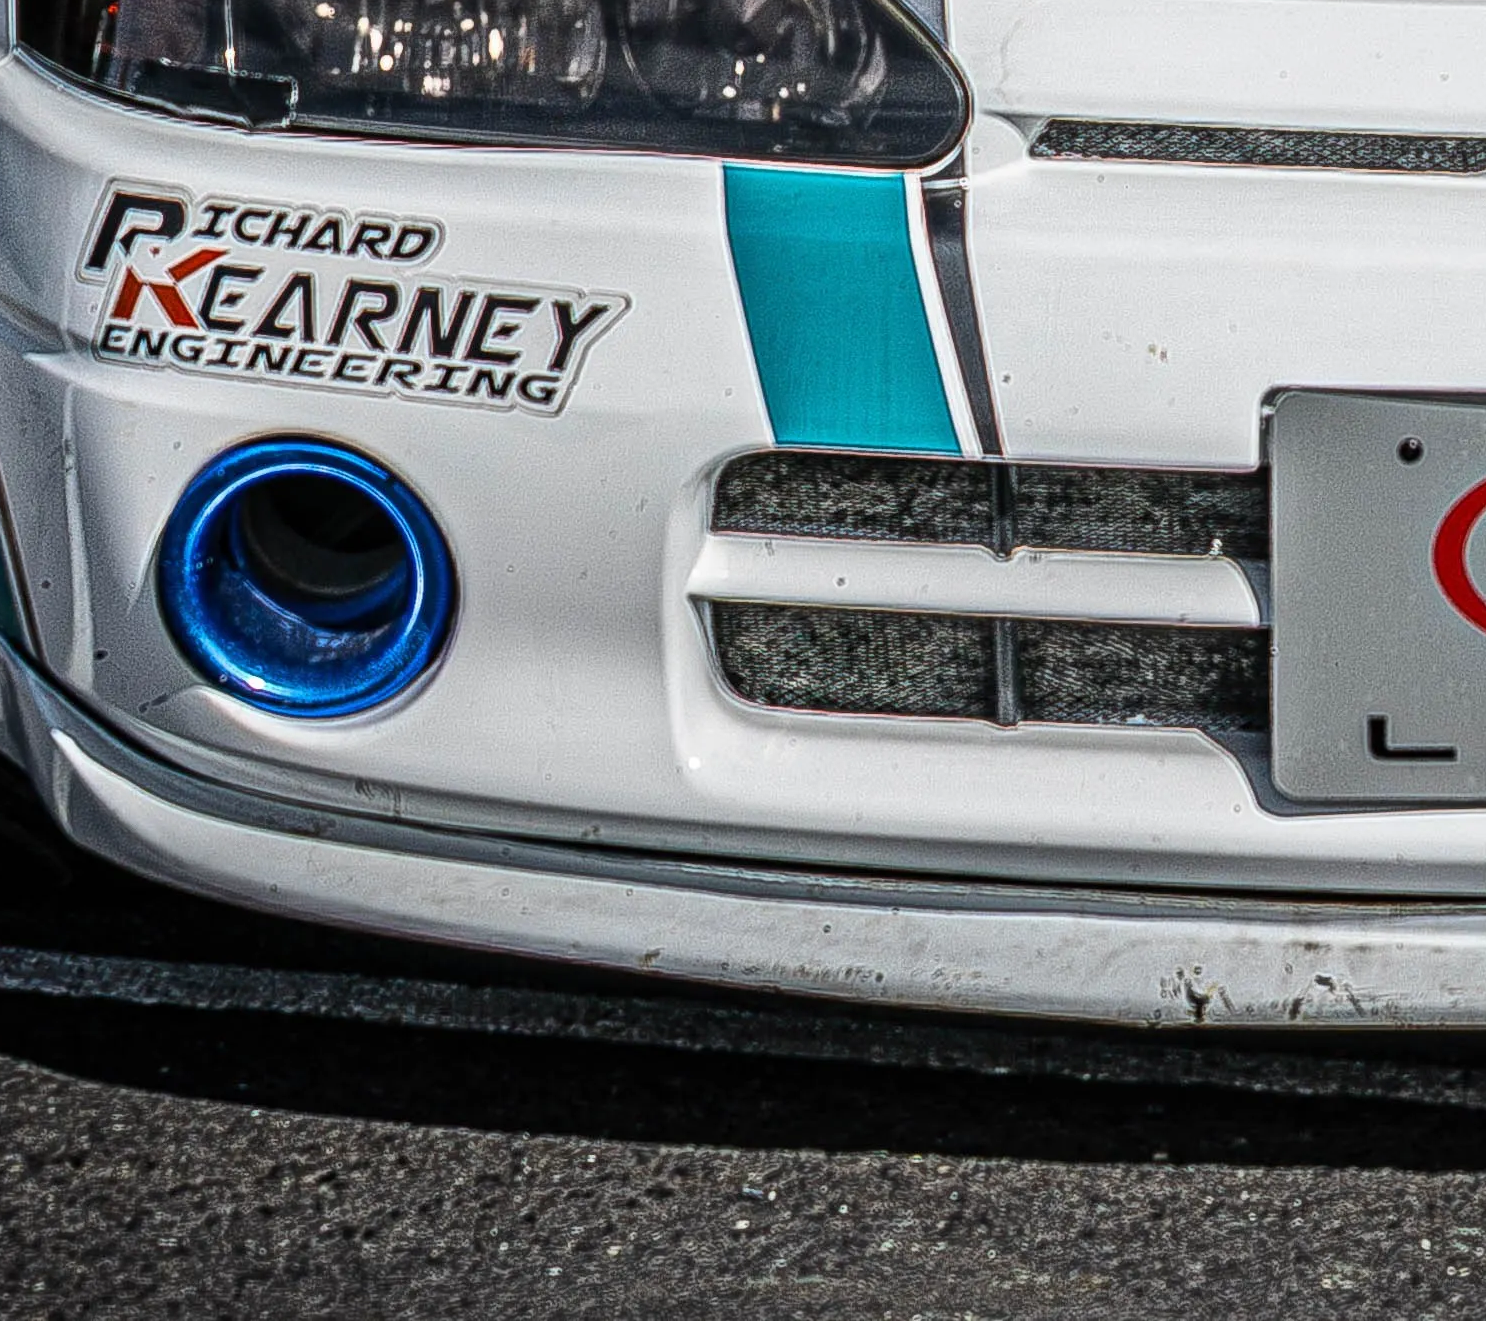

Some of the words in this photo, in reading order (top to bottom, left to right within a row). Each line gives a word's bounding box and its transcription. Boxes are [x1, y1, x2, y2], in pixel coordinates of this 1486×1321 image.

[87, 191, 439, 271] RICHARD
[109, 247, 613, 373] KEARNEY
[99, 324, 565, 406] ENGINEERING
